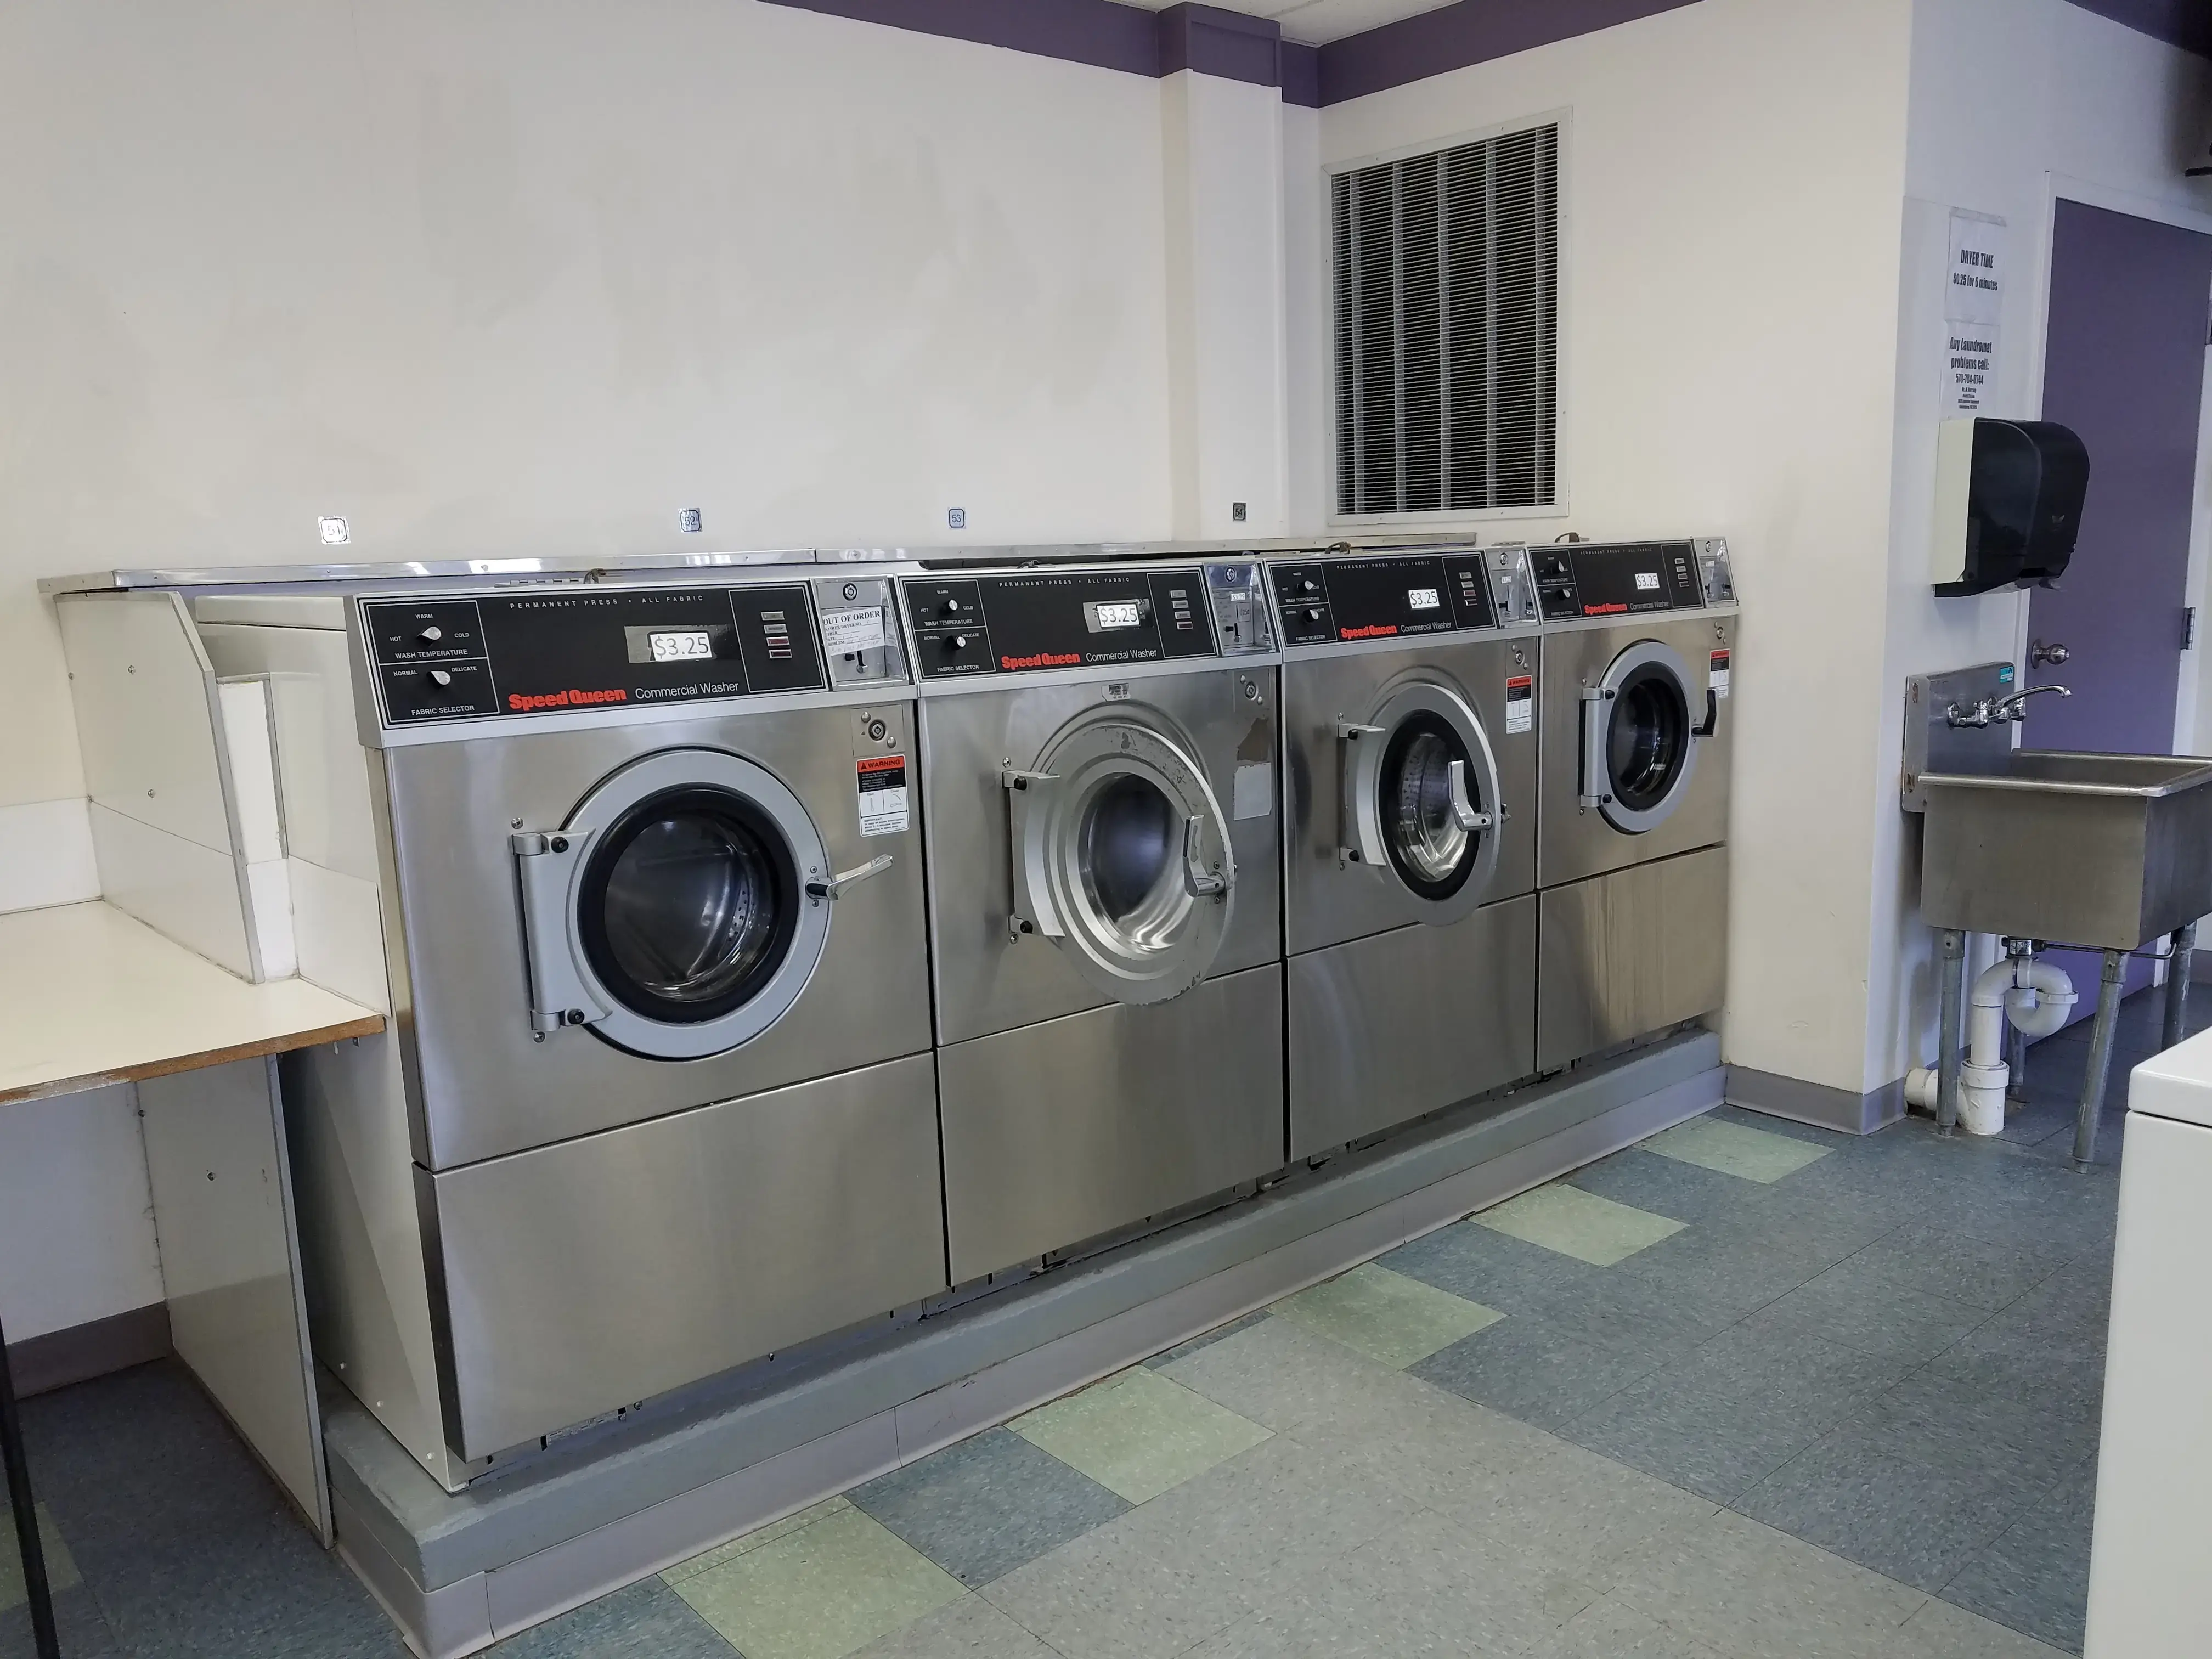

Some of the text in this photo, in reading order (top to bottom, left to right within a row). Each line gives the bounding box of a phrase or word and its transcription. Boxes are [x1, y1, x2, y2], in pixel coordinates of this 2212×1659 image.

[1961, 249, 1994, 268] DRYER TIME
[1953, 272, 1967, 286] $0.25
[1975, 276, 1979, 287] 6
[1979, 278, 1998, 291] minutes
[1949, 337, 1992, 353] Any Laundromat
[1951, 356, 1989, 370] problems call:
[685, 516, 696, 526] 52
[952, 514, 961, 522] 53
[1637, 575, 1658, 588] $3.25
[510, 600, 577, 609] PERMANENT
[1410, 591, 1438, 607] $3.25
[823, 610, 881, 625] OUT OF ORDER
[1100, 607, 1138, 625] $3.25
[1341, 622, 1452, 640] Speed Queen Commercial Washer
[394, 648, 468, 659] WASH TEMPERATURE
[654, 635, 709, 659] $3.25
[1001, 648, 1158, 670] Speed Queen Commercial Washer
[509, 681, 739, 712] Speed Queen Commercial Washer
[411, 704, 475, 716] FABRIC SELECTOR
[868, 759, 900, 768] WARNING
